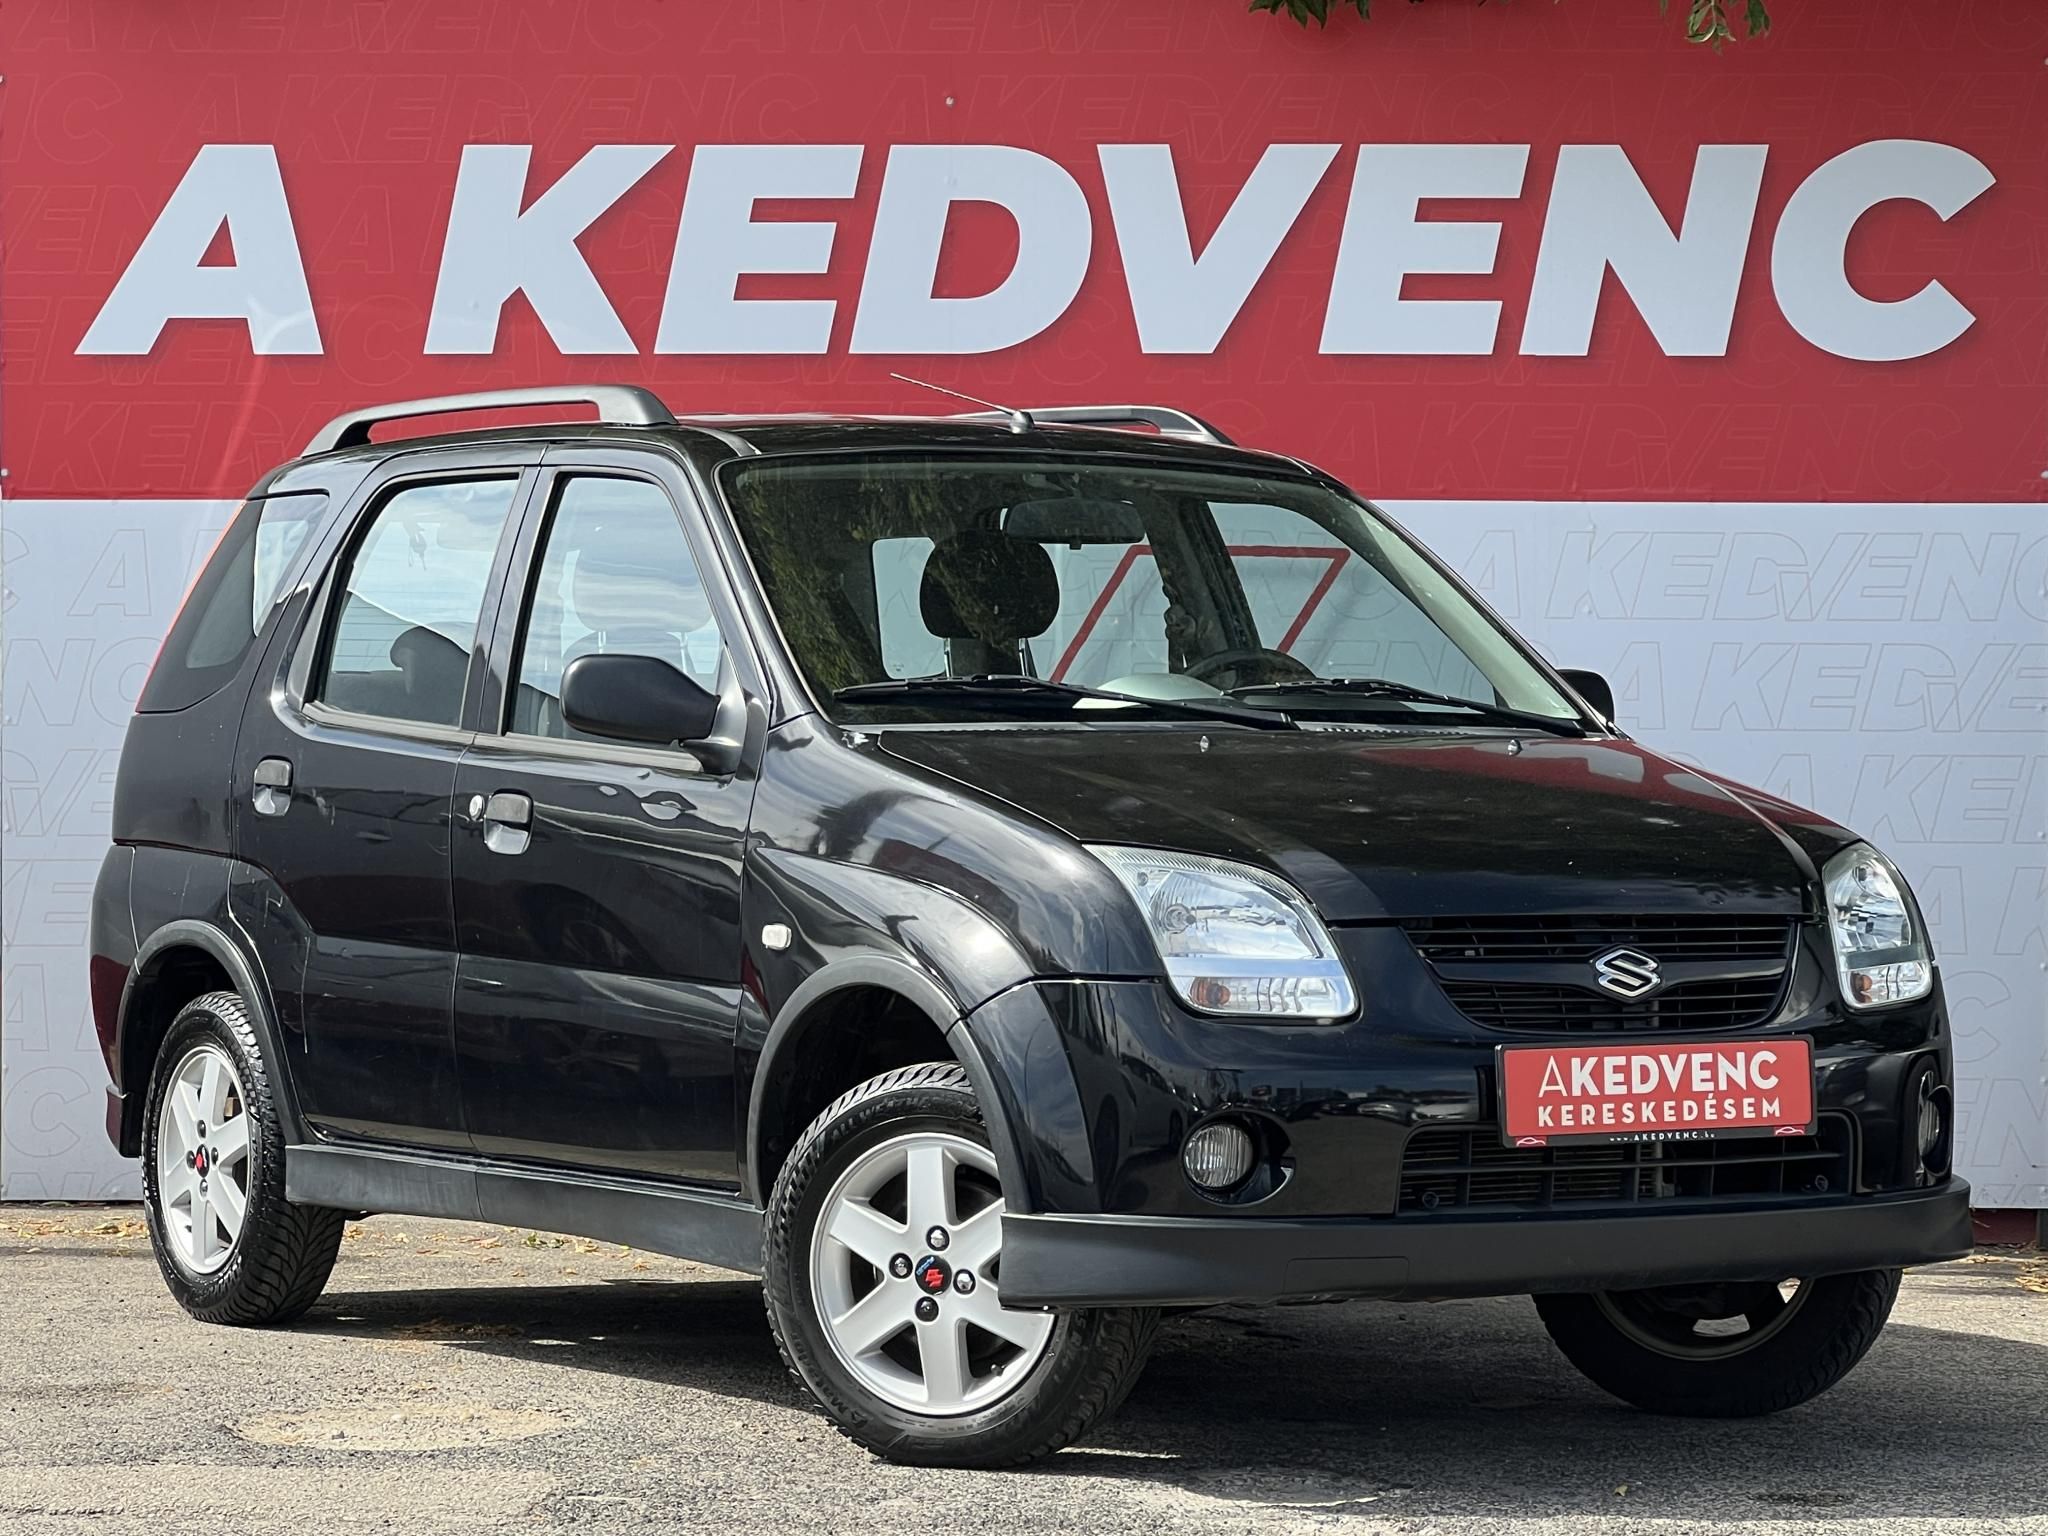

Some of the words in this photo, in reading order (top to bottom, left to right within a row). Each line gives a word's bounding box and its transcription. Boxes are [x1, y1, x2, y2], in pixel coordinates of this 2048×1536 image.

[74, 144, 325, 356] A
[423, 139, 1997, 362] KEDVENC
[1538, 1093, 1781, 1128] KERESKEDÉSEM
